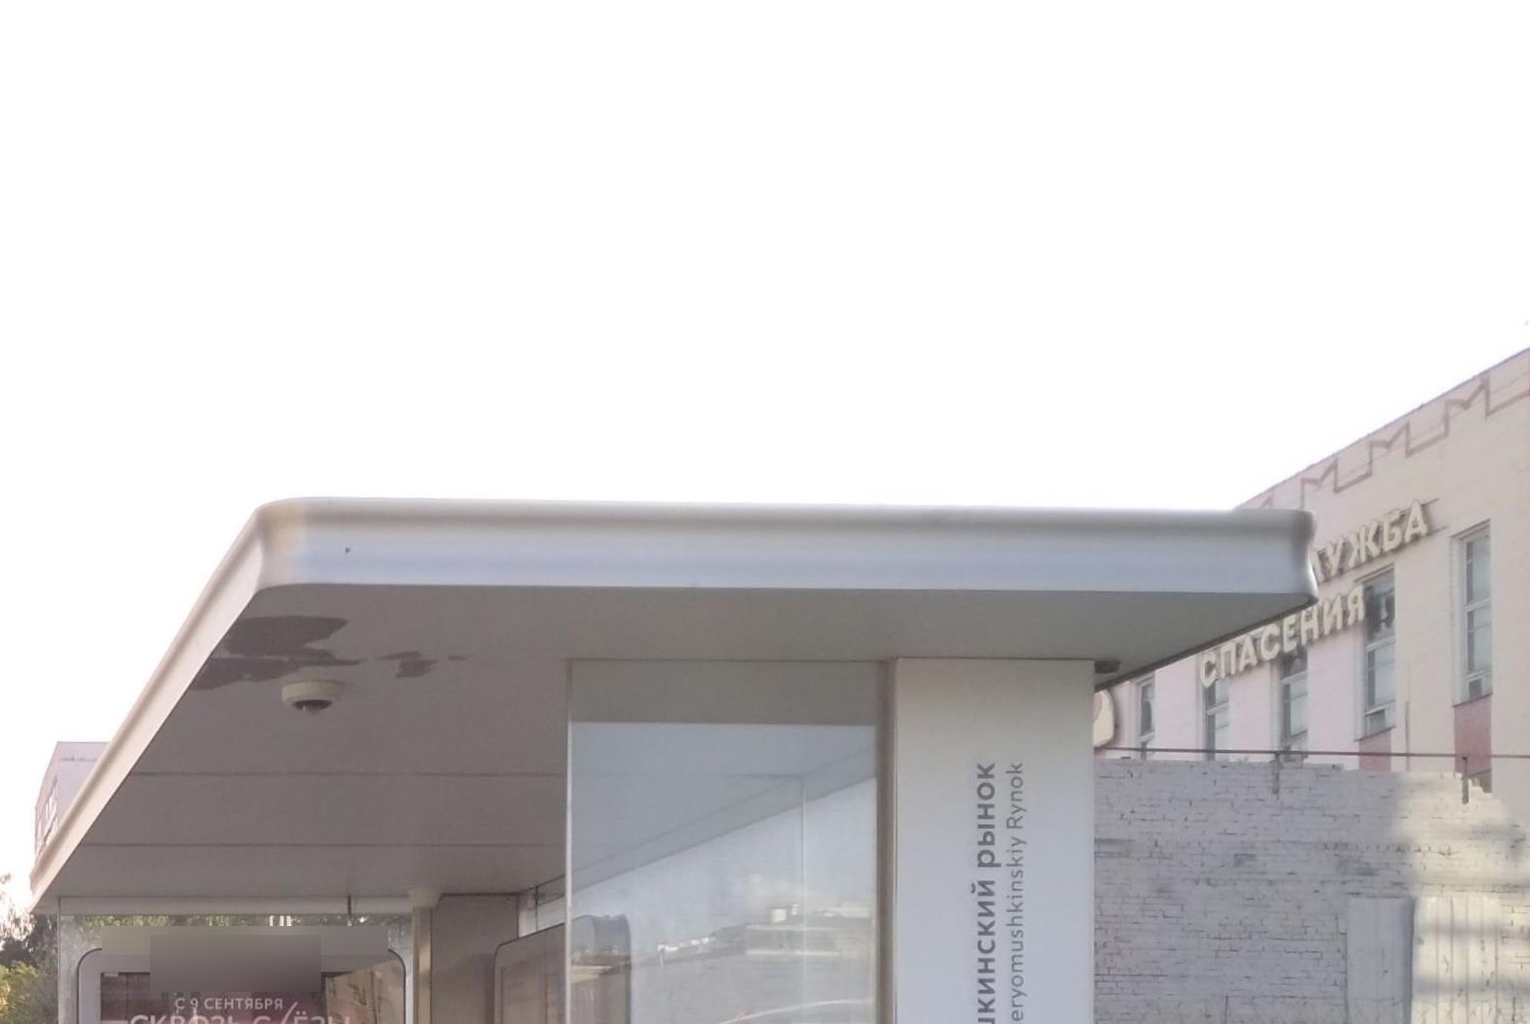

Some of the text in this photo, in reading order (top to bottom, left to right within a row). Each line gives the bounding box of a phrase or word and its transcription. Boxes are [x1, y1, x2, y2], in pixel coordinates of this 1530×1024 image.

[1200, 585, 1366, 689] СПАСЕНИЯ
[976, 762, 1002, 868] рынок
[1005, 762, 1028, 829] Rynok
[175, 998, 283, 1010] С 9 СЕНТЯБРЯ
